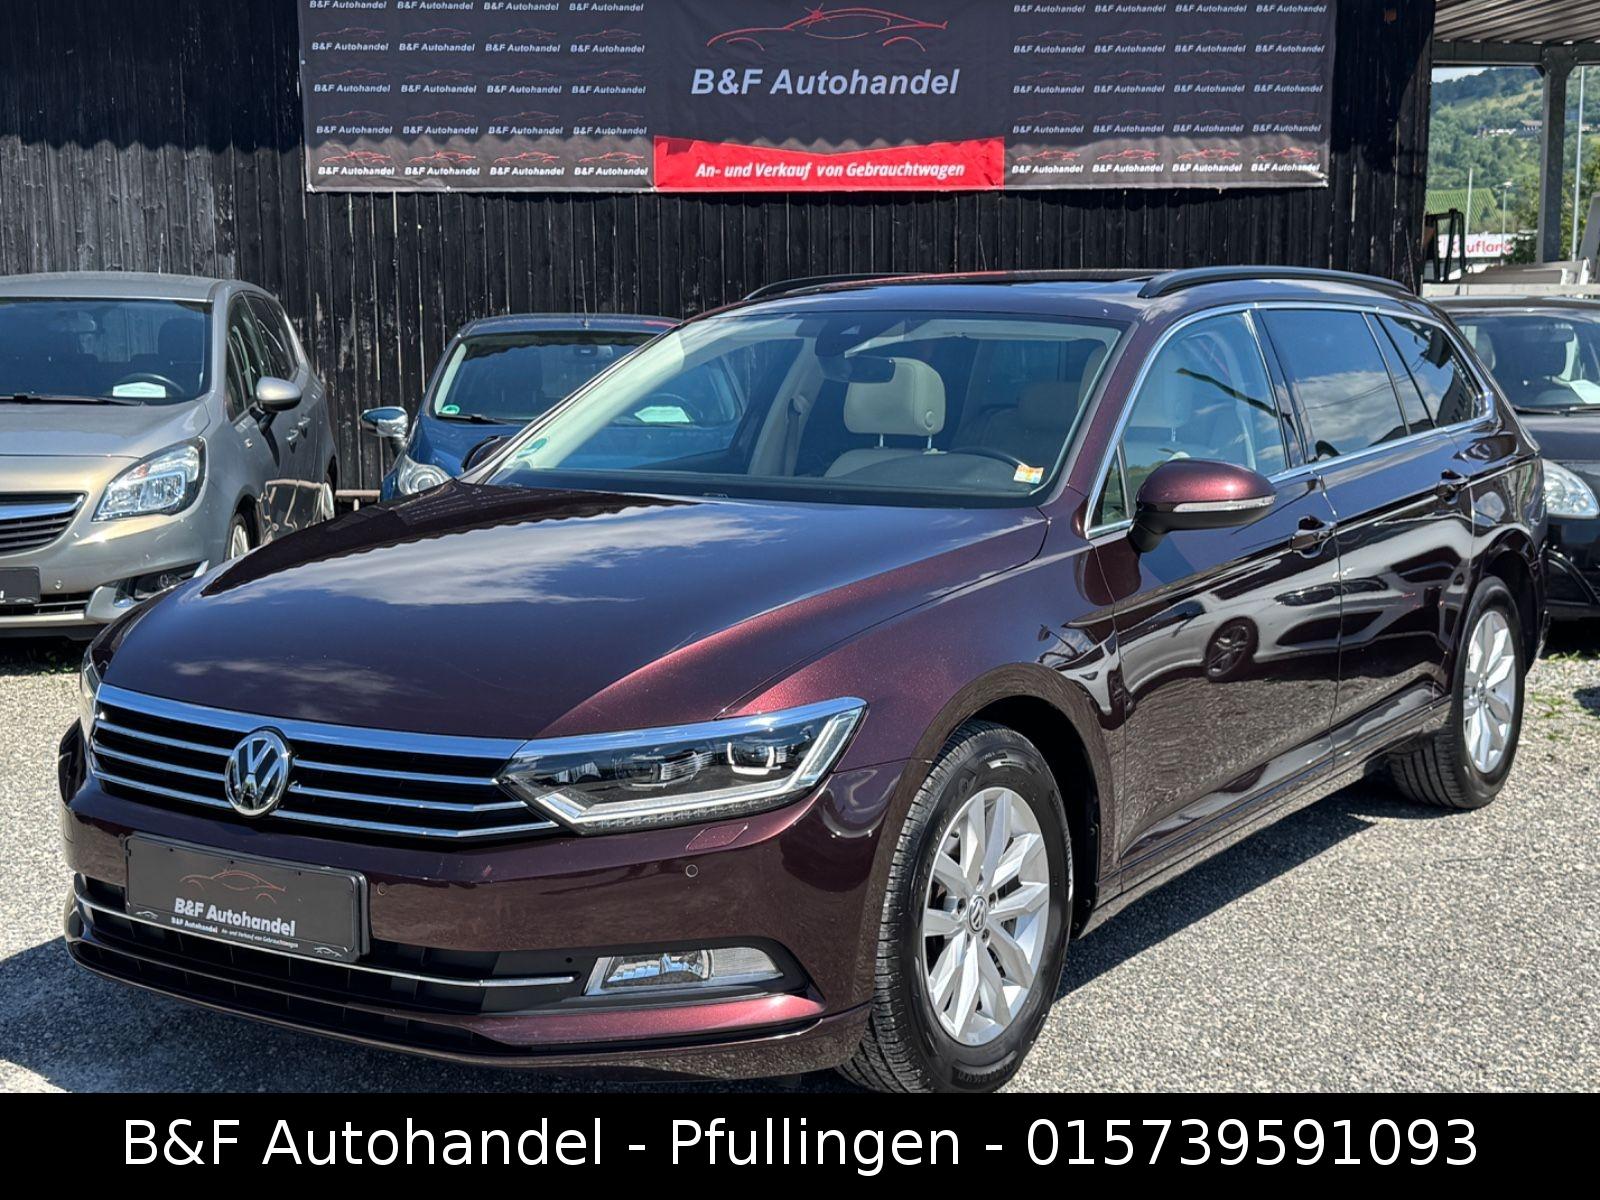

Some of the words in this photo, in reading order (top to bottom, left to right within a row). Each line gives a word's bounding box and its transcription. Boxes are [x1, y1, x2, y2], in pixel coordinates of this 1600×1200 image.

[309, 0, 331, 9] B&F
[331, 0, 387, 9] Autohandel
[397, 0, 418, 9] B&F
[418, 1, 474, 10] Autohandel
[483, 1, 505, 11] B&F
[505, 2, 560, 11] Autohandel
[568, 2, 590, 11] B&F
[590, 2, 644, 12] Autohandel
[1013, 4, 1033, 13] B&F
[1033, 4, 1086, 13] Autohandel
[1094, 4, 1115, 13] B&F
[1115, 4, 1167, 13] Autohandel
[1174, 4, 1195, 13] B&F
[1195, 4, 1248, 13] Autohandel
[1255, 4, 1276, 13] B&F
[1276, 4, 1327, 13] Autohandel
[311, 41, 333, 51] B&F
[333, 42, 390, 51] Autohandel
[398, 42, 420, 51] B&F
[420, 43, 476, 52] Autohandel
[485, 43, 506, 52] B&F
[506, 43, 561, 53] Autohandel
[570, 44, 591, 53] B&F
[591, 44, 645, 53] Autohandel
[1013, 44, 1033, 54] B&F
[1033, 44, 1086, 54] Autohandel
[1093, 44, 1114, 54] B&F
[1114, 44, 1166, 53] Autohandel
[1174, 44, 1194, 53] B&F
[1195, 44, 1247, 53] Autohandel
[1254, 44, 1275, 53] B&F
[1275, 44, 1326, 53] Autohandel
[691, 68, 763, 95] B&F
[769, 68, 960, 95] Autohandel
[313, 83, 335, 93] B&F
[336, 84, 391, 93] Autohandel
[400, 84, 422, 93] B&F
[422, 84, 477, 94] Autohandel
[486, 84, 508, 94] B&F
[508, 85, 562, 94] Autohandel
[571, 85, 592, 94] B&F
[593, 85, 647, 94] Autohandel
[1013, 85, 1033, 94] B&F
[1033, 85, 1085, 94] Autohandel
[1093, 84, 1113, 94] B&F
[1113, 84, 1166, 93] Autohandel
[1173, 84, 1194, 93] B&F
[1194, 84, 1246, 93] Autohandel
[1253, 84, 1274, 93] B&F
[1273, 84, 1324, 93] Autohandel
[316, 125, 337, 134] B&F
[338, 125, 393, 134] Autohandel
[402, 125, 423, 135] B&F
[424, 125, 479, 135] Autohandel
[488, 126, 509, 135] B&F
[509, 126, 564, 135] Autohandel
[572, 126, 593, 135] B&F
[594, 126, 647, 135] Autohandel
[1012, 125, 1032, 134] B&F
[1032, 125, 1085, 134] Autohandel
[1092, 124, 1113, 133] B&F
[1113, 124, 1165, 133] Autohandel
[1172, 123, 1192, 133] B&F
[1192, 124, 1245, 133] Autohandel
[1252, 123, 1272, 133] B&F
[1272, 124, 1322, 133] Autohandel
[317, 166, 340, 176] B&F
[340, 166, 395, 176] Autohandel
[404, 166, 426, 176] B&F
[426, 166, 481, 176] Autohandel
[489, 166, 511, 176] B&F
[511, 166, 565, 176] Autohandel
[574, 166, 595, 176] B&F
[595, 166, 649, 176] Autohandel
[695, 163, 721, 178] An-
[724, 162, 753, 178] und
[755, 162, 812, 182] Verkauf
[816, 165, 843, 178] von
[846, 162, 965, 181] Gebrauchtwagen
[1011, 164, 1032, 174] B&F
[1032, 164, 1084, 174] Autohandel
[1091, 163, 1113, 173] B&F
[1112, 163, 1165, 173] Autohandel
[1171, 163, 1192, 172] B&F
[1192, 163, 1243, 172] Autohandel
[1250, 162, 1271, 172] B&F
[1270, 162, 1321, 173] Autohandel
[174, 898, 204, 917] B&F
[206, 905, 296, 937] Autohandel
